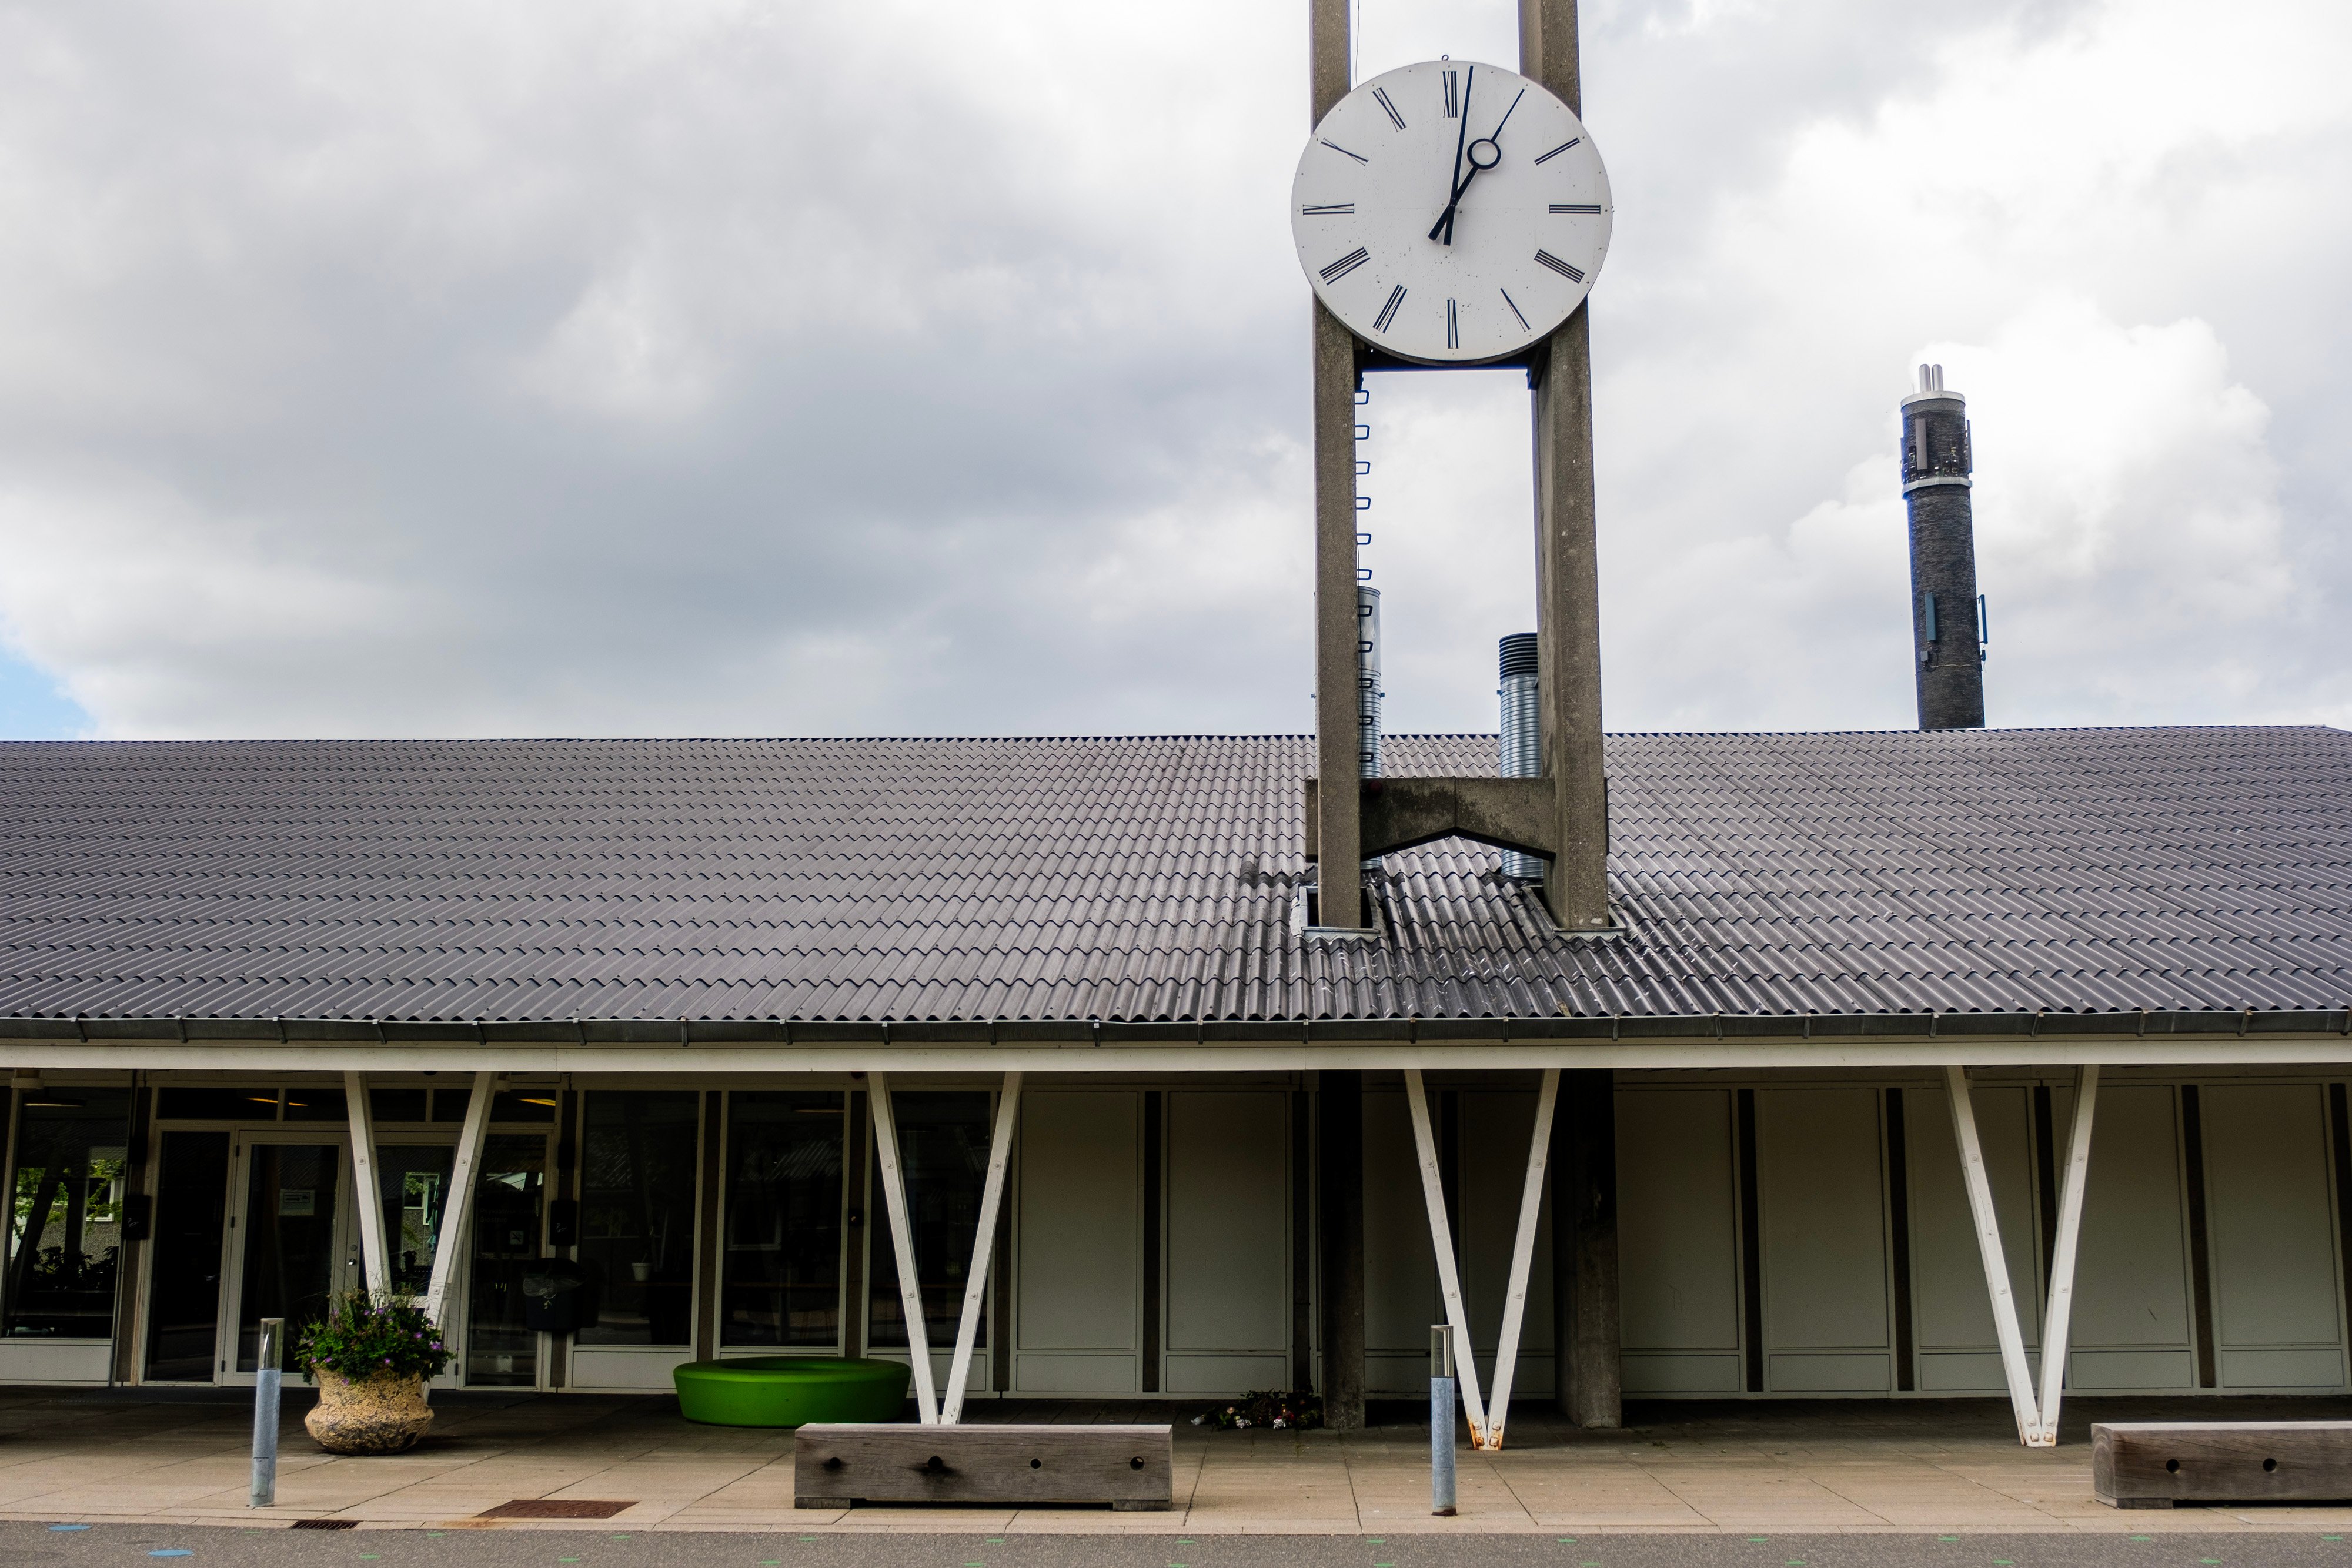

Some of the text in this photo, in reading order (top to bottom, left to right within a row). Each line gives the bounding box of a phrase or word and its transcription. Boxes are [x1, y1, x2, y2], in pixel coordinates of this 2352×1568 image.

[1372, 86, 1406, 132] XI
[1442, 71, 1458, 118] XII
[1321, 137, 1369, 167] X
[1534, 137, 1581, 166] II
[1302, 202, 1355, 216] IX
[1548, 203, 1601, 215] III
[1318, 246, 1371, 286] VIII
[1534, 248, 1585, 285] IIII
[1372, 284, 1408, 334] VII
[1446, 299, 1459, 349] VI
[1500, 287, 1531, 333] V
